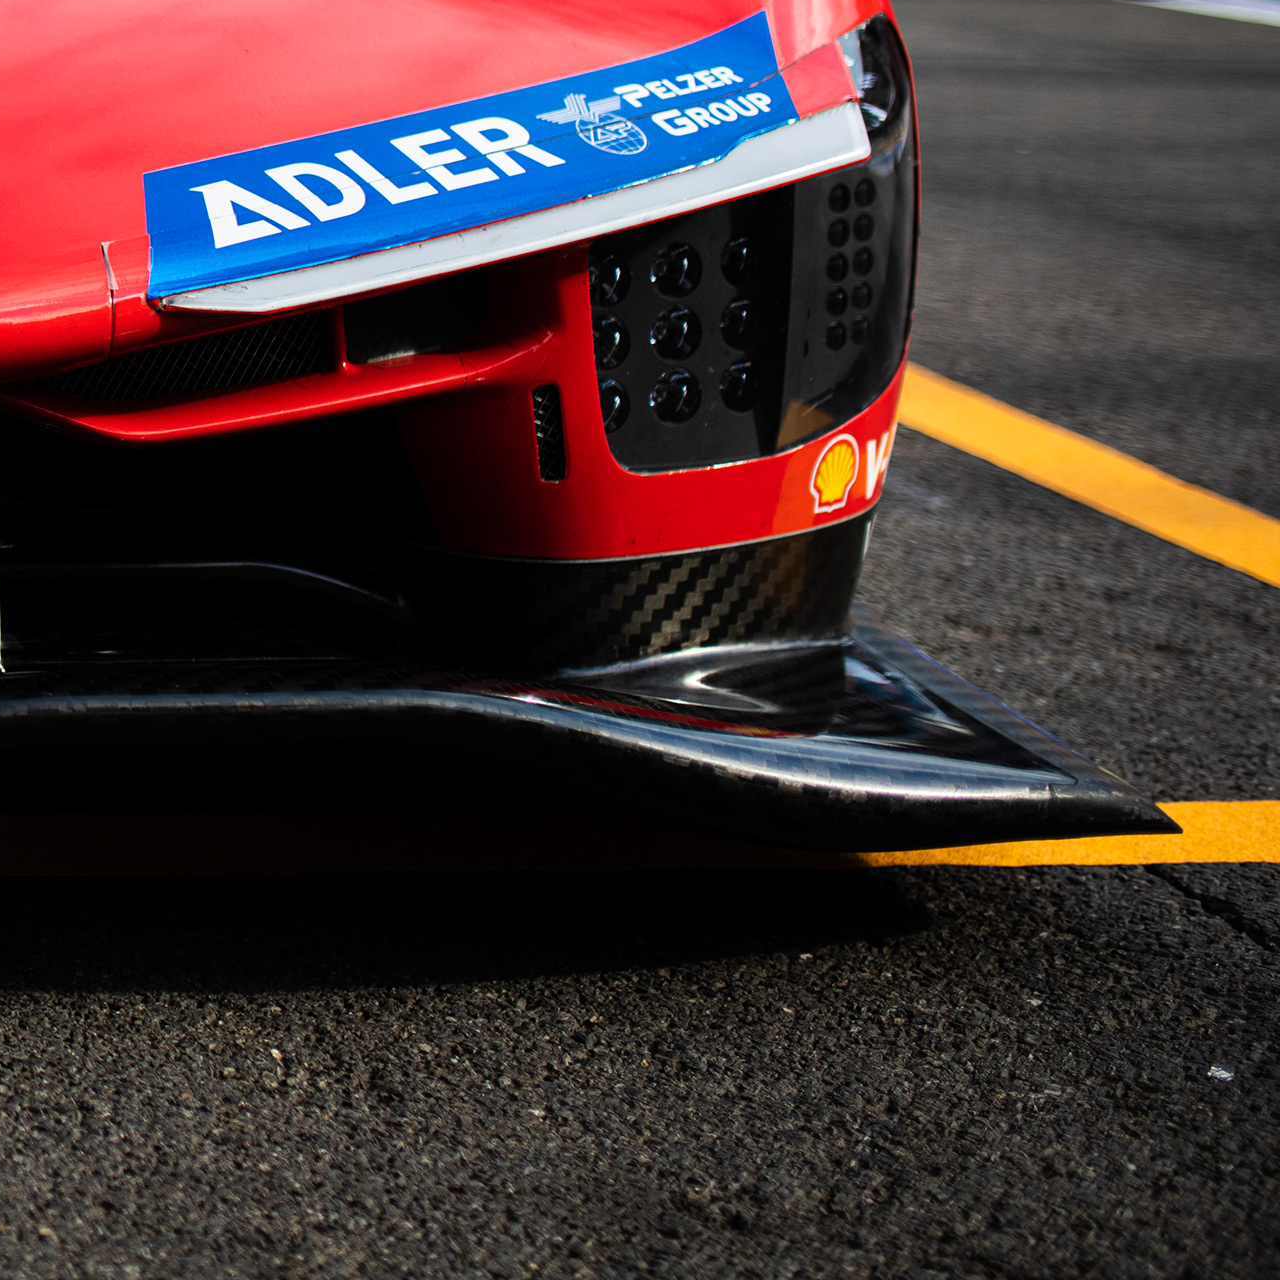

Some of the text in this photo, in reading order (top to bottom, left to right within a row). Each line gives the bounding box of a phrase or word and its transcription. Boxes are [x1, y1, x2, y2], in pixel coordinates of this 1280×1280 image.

[612, 66, 744, 109] PELZER
[651, 92, 772, 137] GROUP
[188, 117, 566, 249] ADLER
